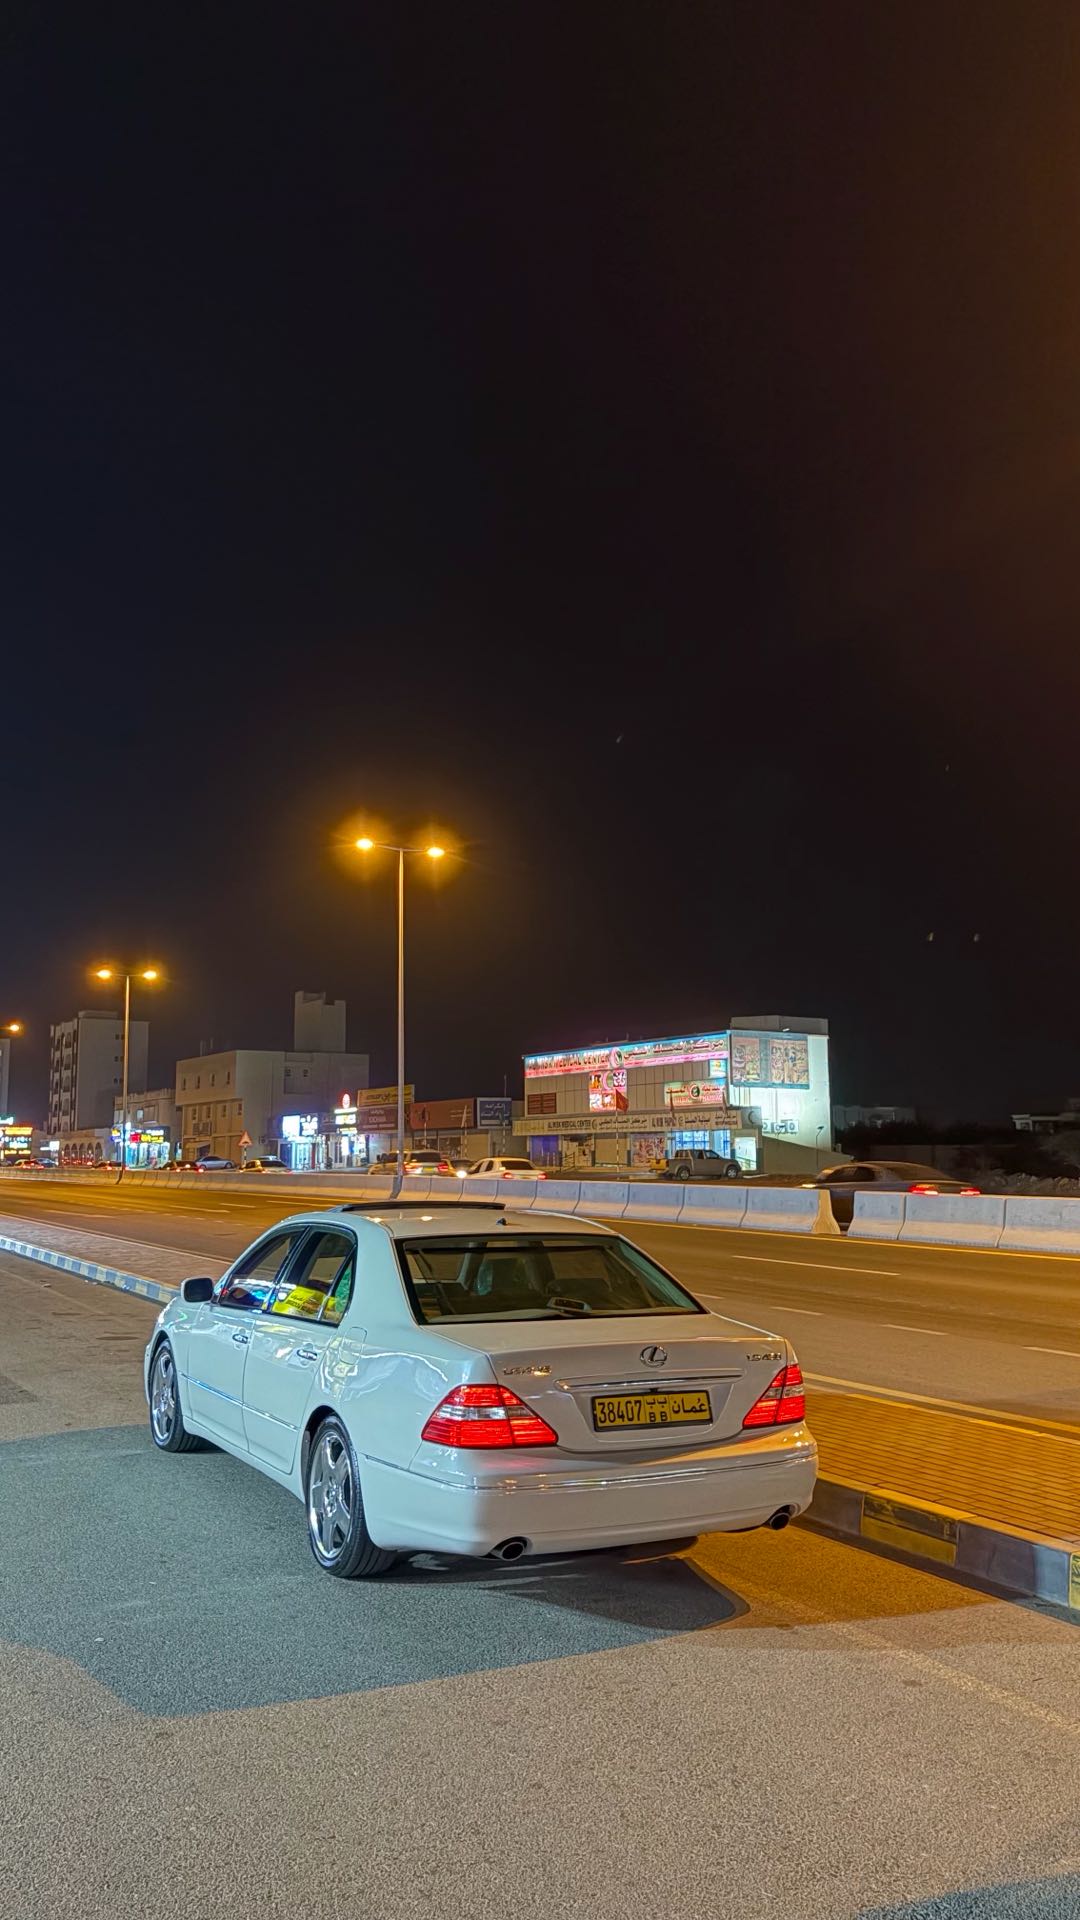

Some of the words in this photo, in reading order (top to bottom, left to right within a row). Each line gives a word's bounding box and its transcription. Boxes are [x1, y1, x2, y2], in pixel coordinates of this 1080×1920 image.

[554, 1053, 581, 1068] MEDICAL
[583, 1050, 609, 1065] CENTER
[597, 1399, 642, 1424] 38407
